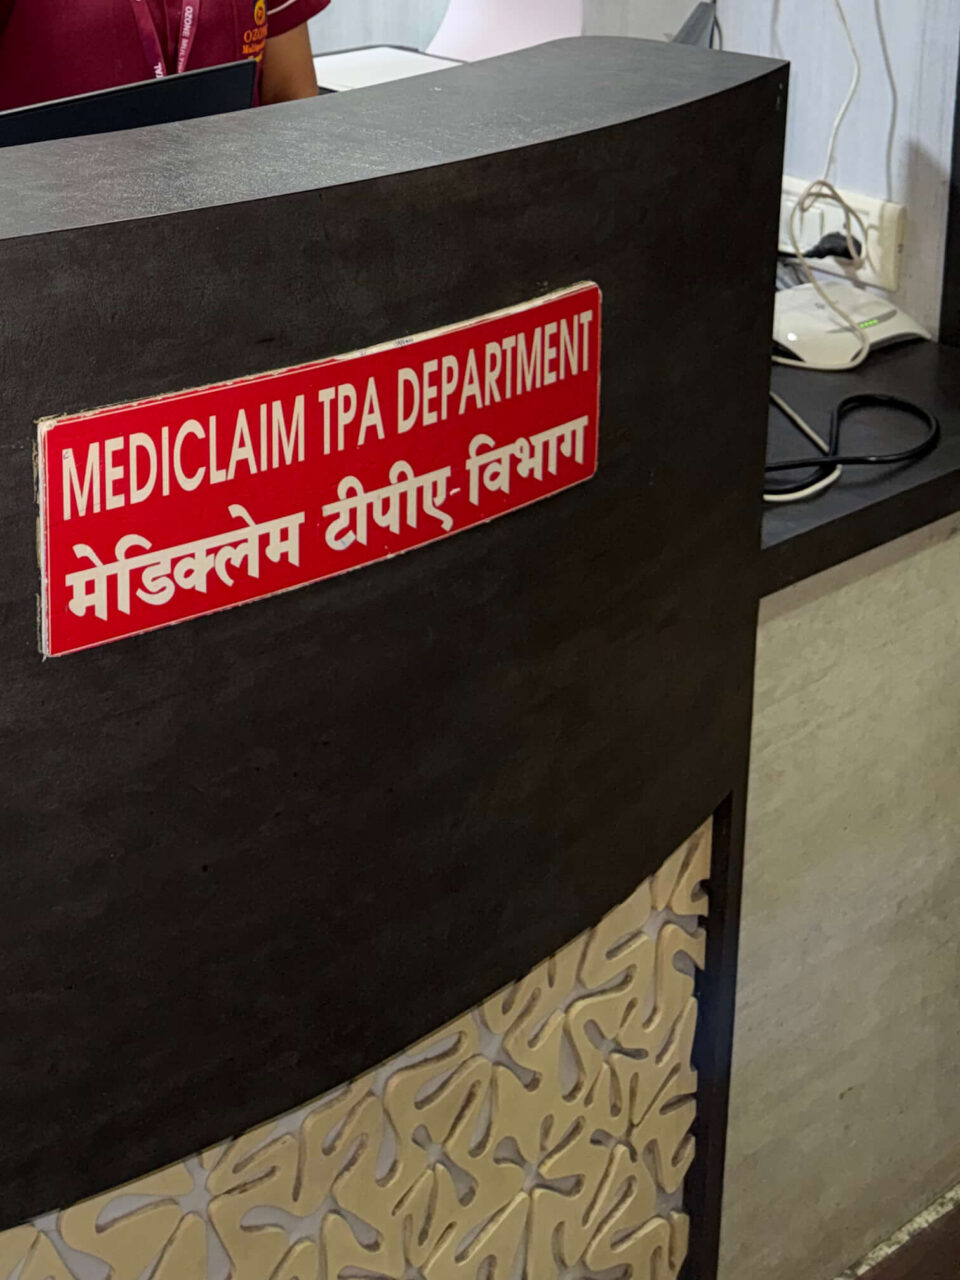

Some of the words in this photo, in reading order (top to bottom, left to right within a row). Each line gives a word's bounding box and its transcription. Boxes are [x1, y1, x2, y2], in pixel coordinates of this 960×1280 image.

[183, 5, 194, 37] OZONE
[61, 393, 306, 520] MEDICLAIM
[318, 376, 385, 455] TPA
[397, 310, 593, 434] DEPARTMENT
[65, 505, 306, 620] मेडिक्लेम
[322, 460, 454, 552] टीपीए
[466, 415, 589, 506] विभाग
